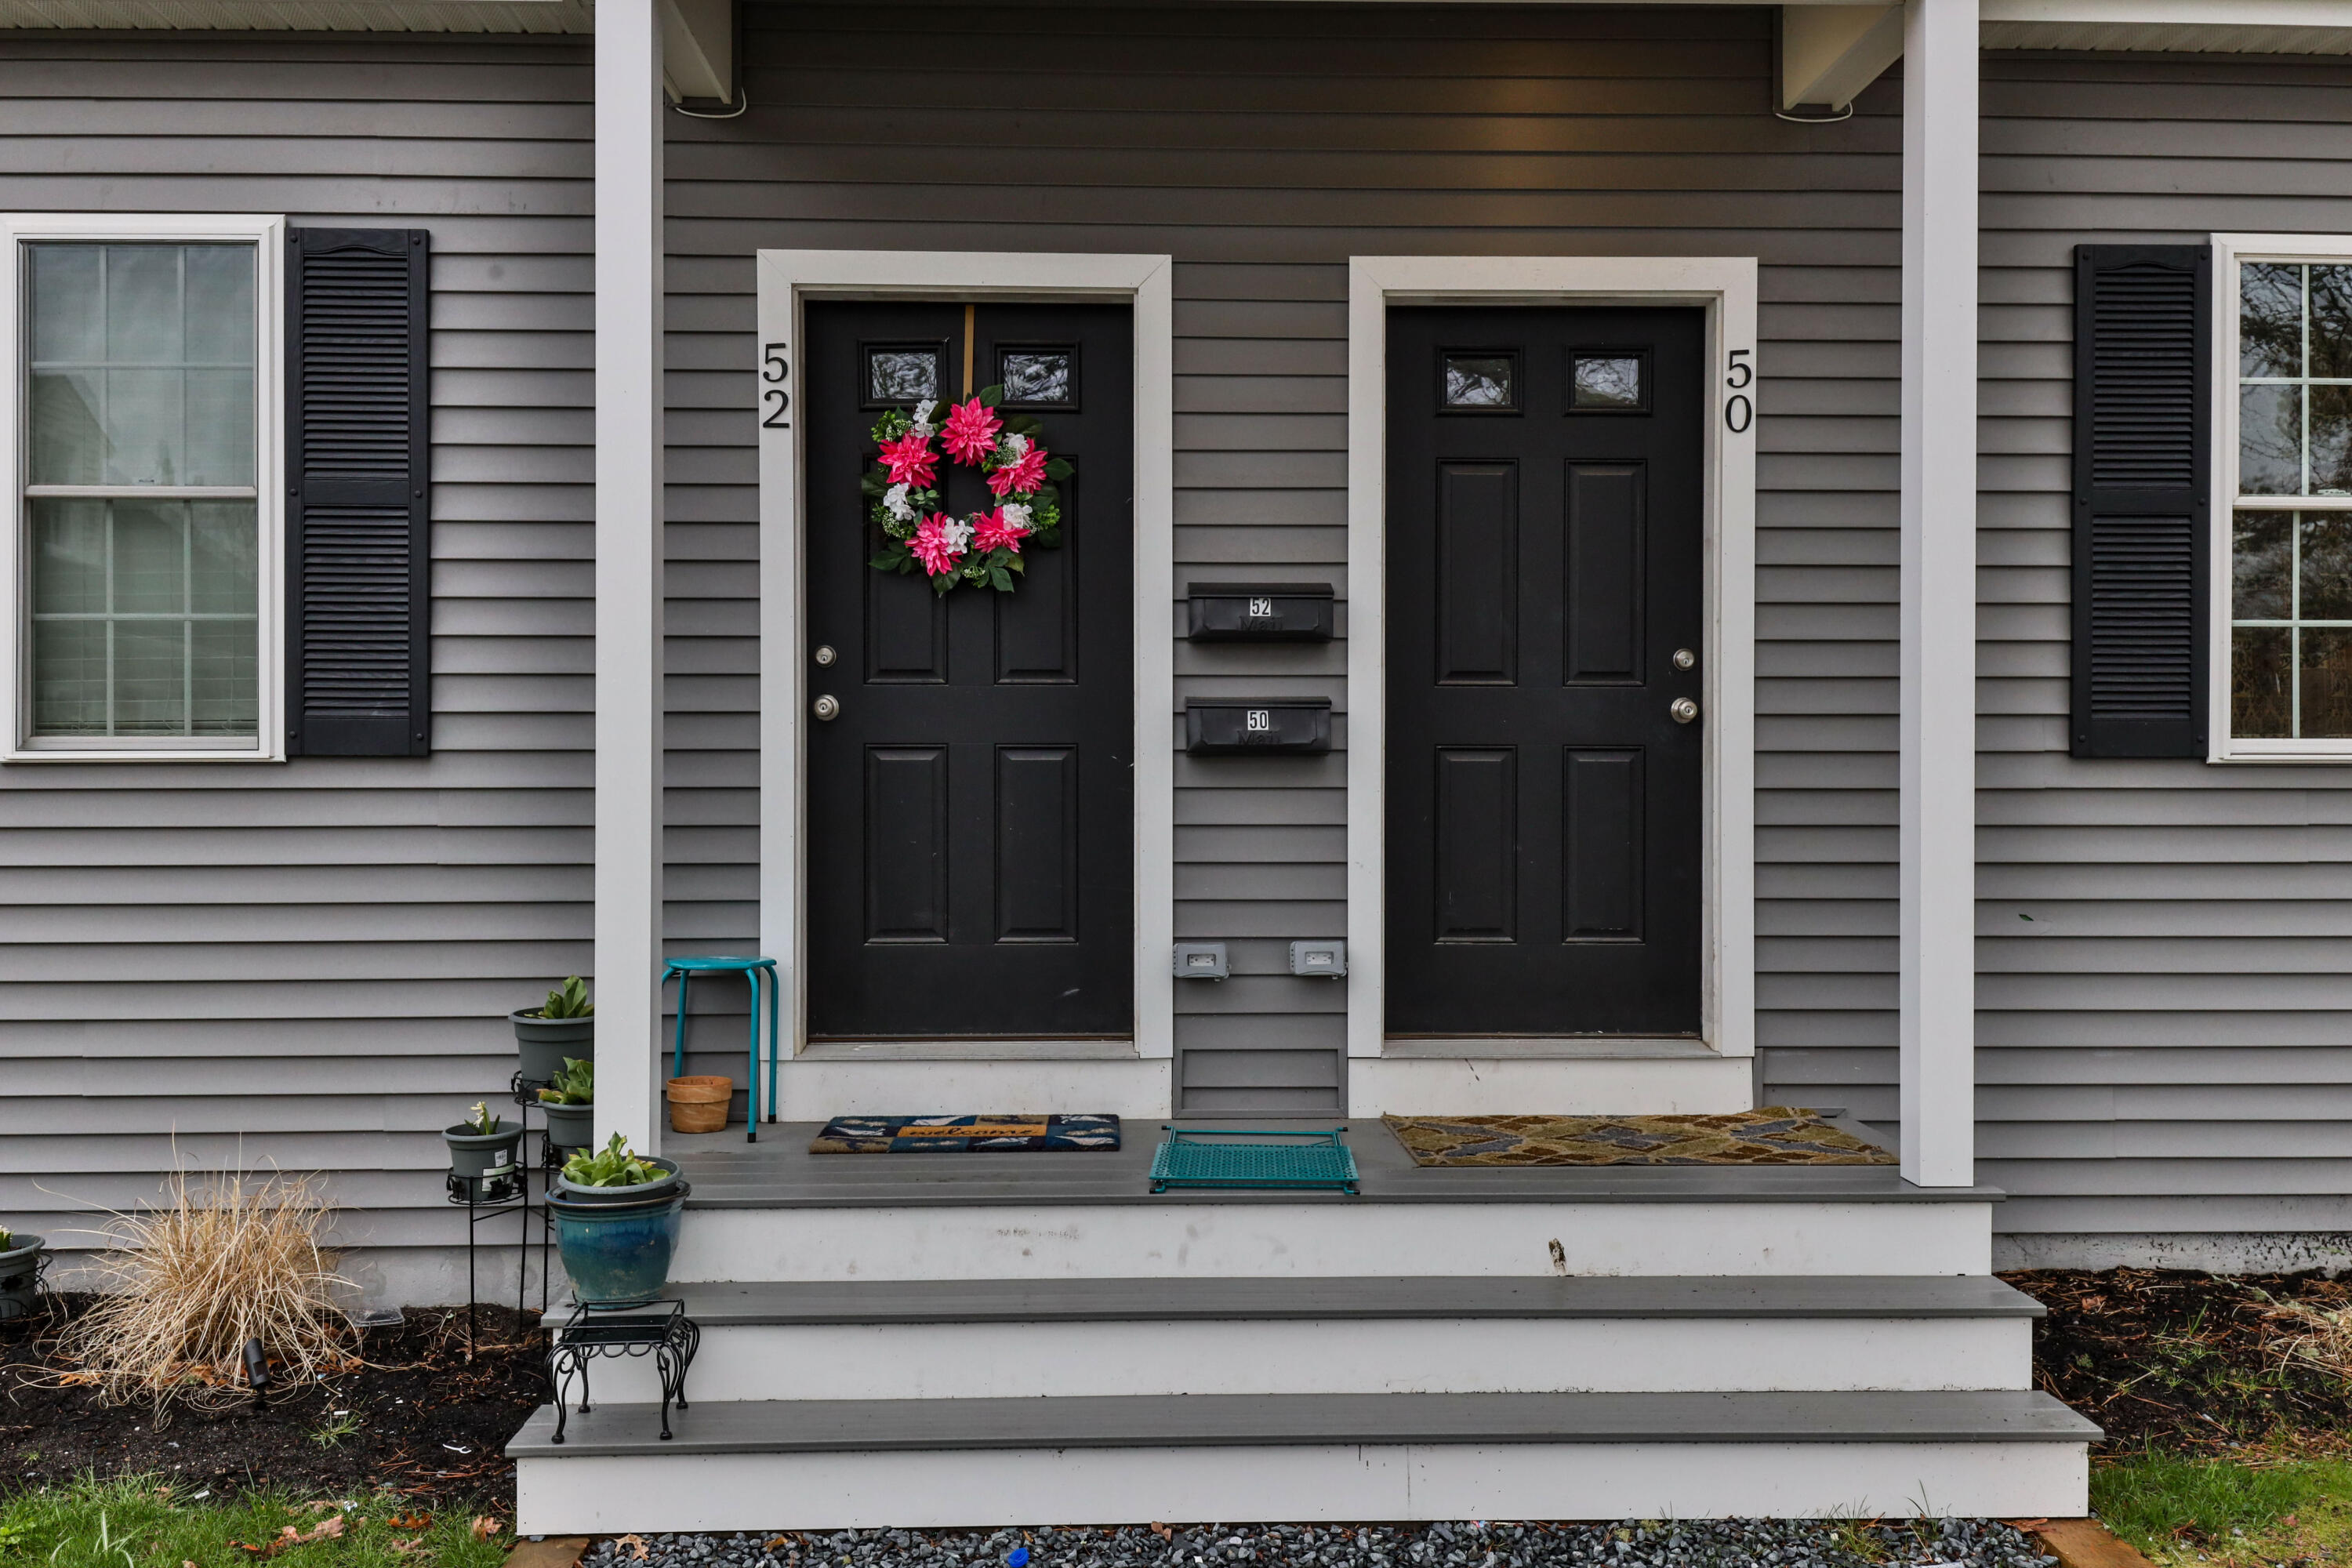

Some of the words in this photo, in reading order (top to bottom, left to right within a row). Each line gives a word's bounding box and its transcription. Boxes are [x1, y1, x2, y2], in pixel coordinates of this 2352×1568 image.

[763, 343, 789, 428] 52
[1725, 350, 1752, 433] 50
[1252, 597, 1269, 615] 52
[1250, 711, 1268, 729] 50
